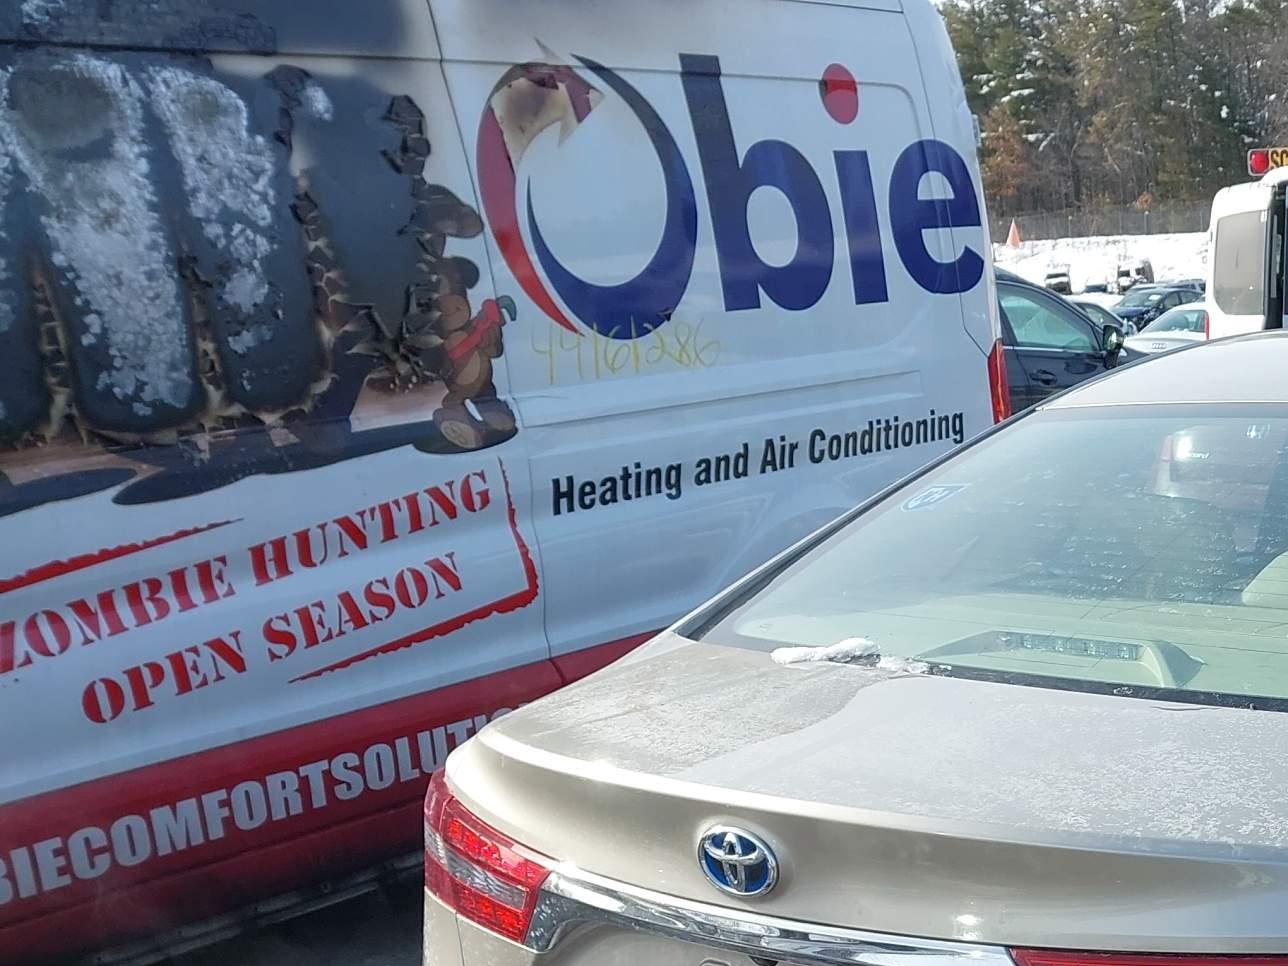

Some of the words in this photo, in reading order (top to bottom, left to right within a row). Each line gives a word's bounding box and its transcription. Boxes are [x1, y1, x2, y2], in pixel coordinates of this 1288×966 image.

[476, 37, 985, 340] Obie
[552, 462, 682, 516] Heating
[694, 443, 750, 487] and
[760, 429, 799, 473] Air
[808, 410, 965, 465] Conditioning
[0, 555, 236, 674] ZOMBIE
[247, 470, 491, 586] HUNTING
[82, 630, 247, 724] OPEN
[262, 552, 463, 663] SEASON
[0, 703, 528, 902] IECOMFORTSOLUT
